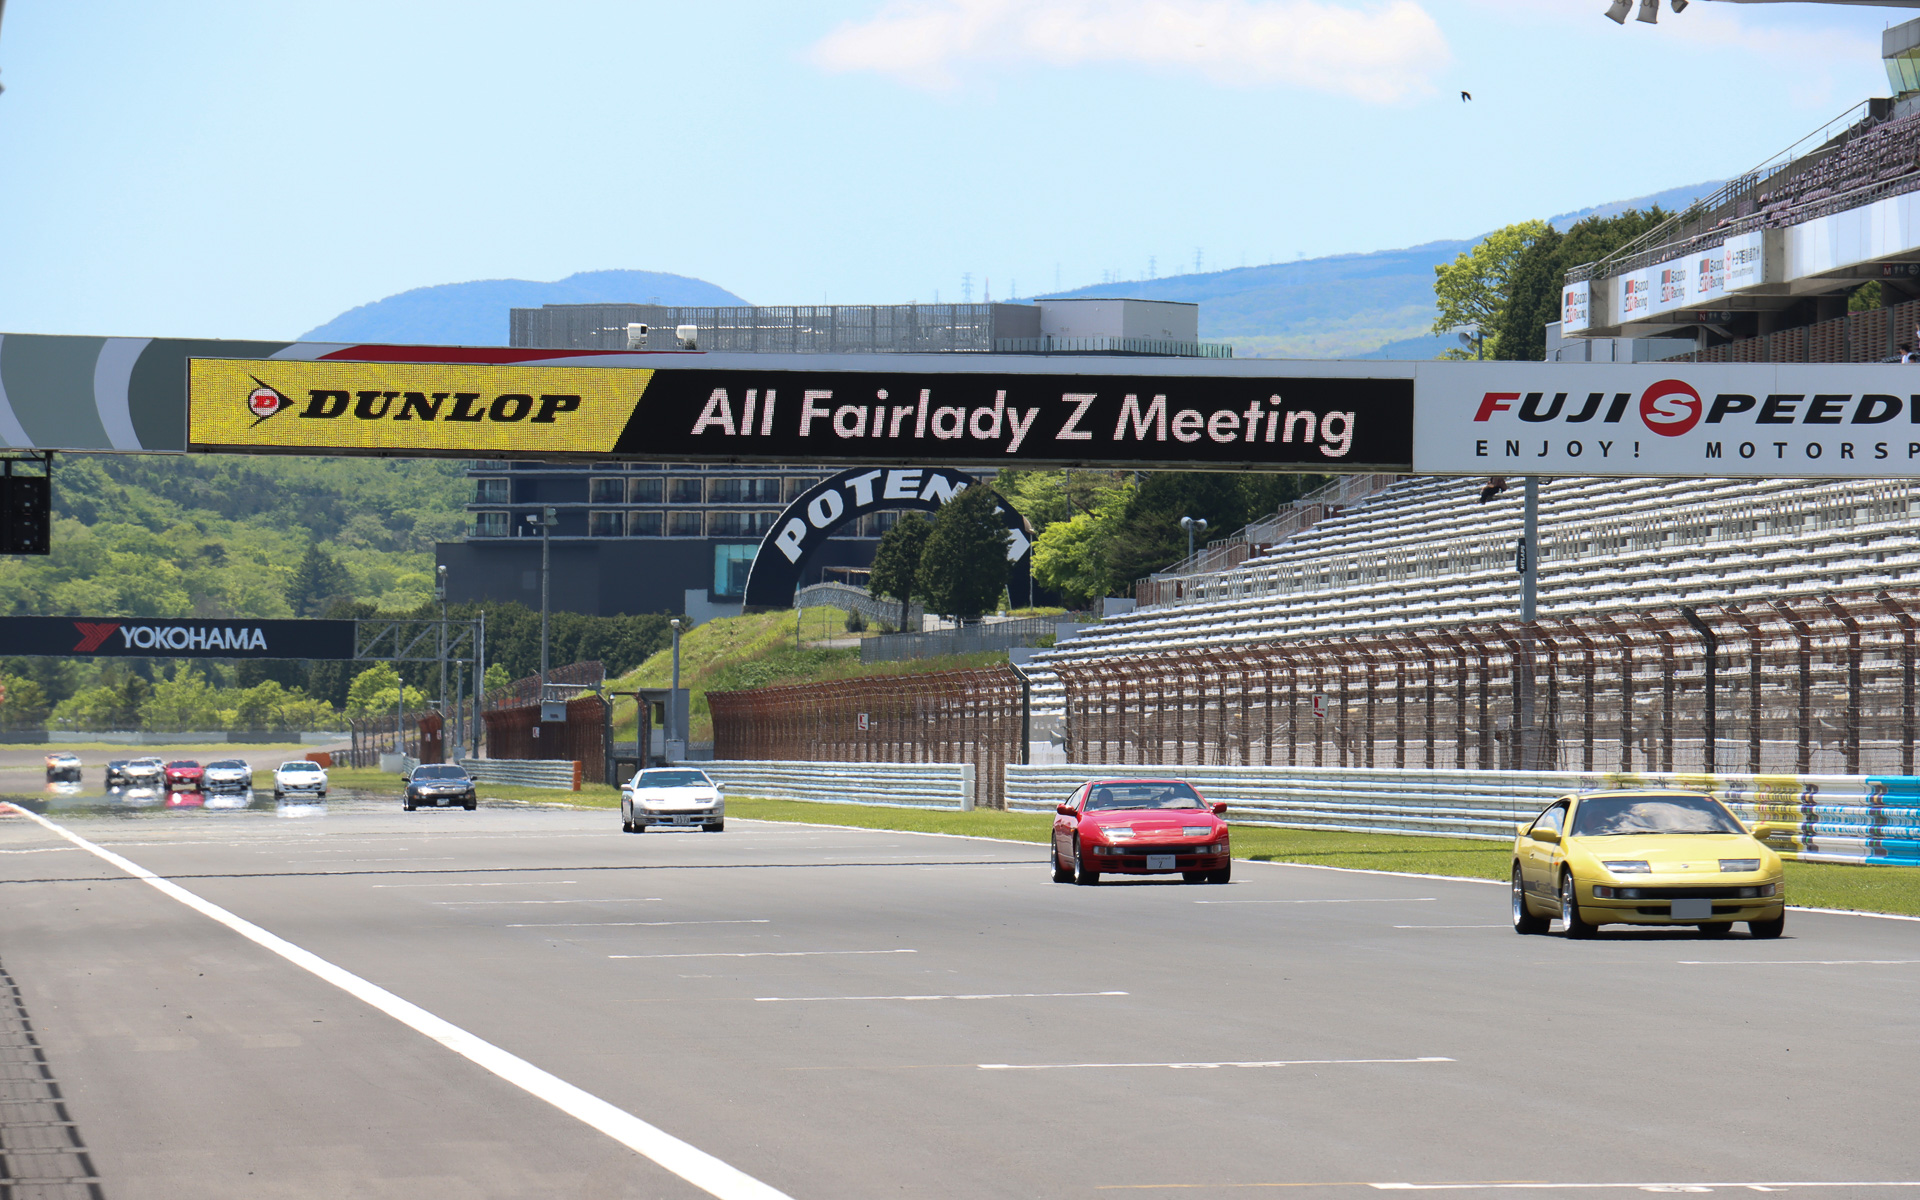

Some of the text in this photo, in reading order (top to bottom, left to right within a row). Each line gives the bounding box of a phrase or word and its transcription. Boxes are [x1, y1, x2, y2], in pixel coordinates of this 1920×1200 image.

[1883, 267, 1892, 275] M
[300, 389, 581, 423] DUNLOP
[1646, 392, 1920, 425] SPEED
[690, 387, 1356, 457] All Fairlady Z Meeting
[1476, 440, 1640, 458] ENJOY!
[119, 626, 268, 651] YOKOHAMA
